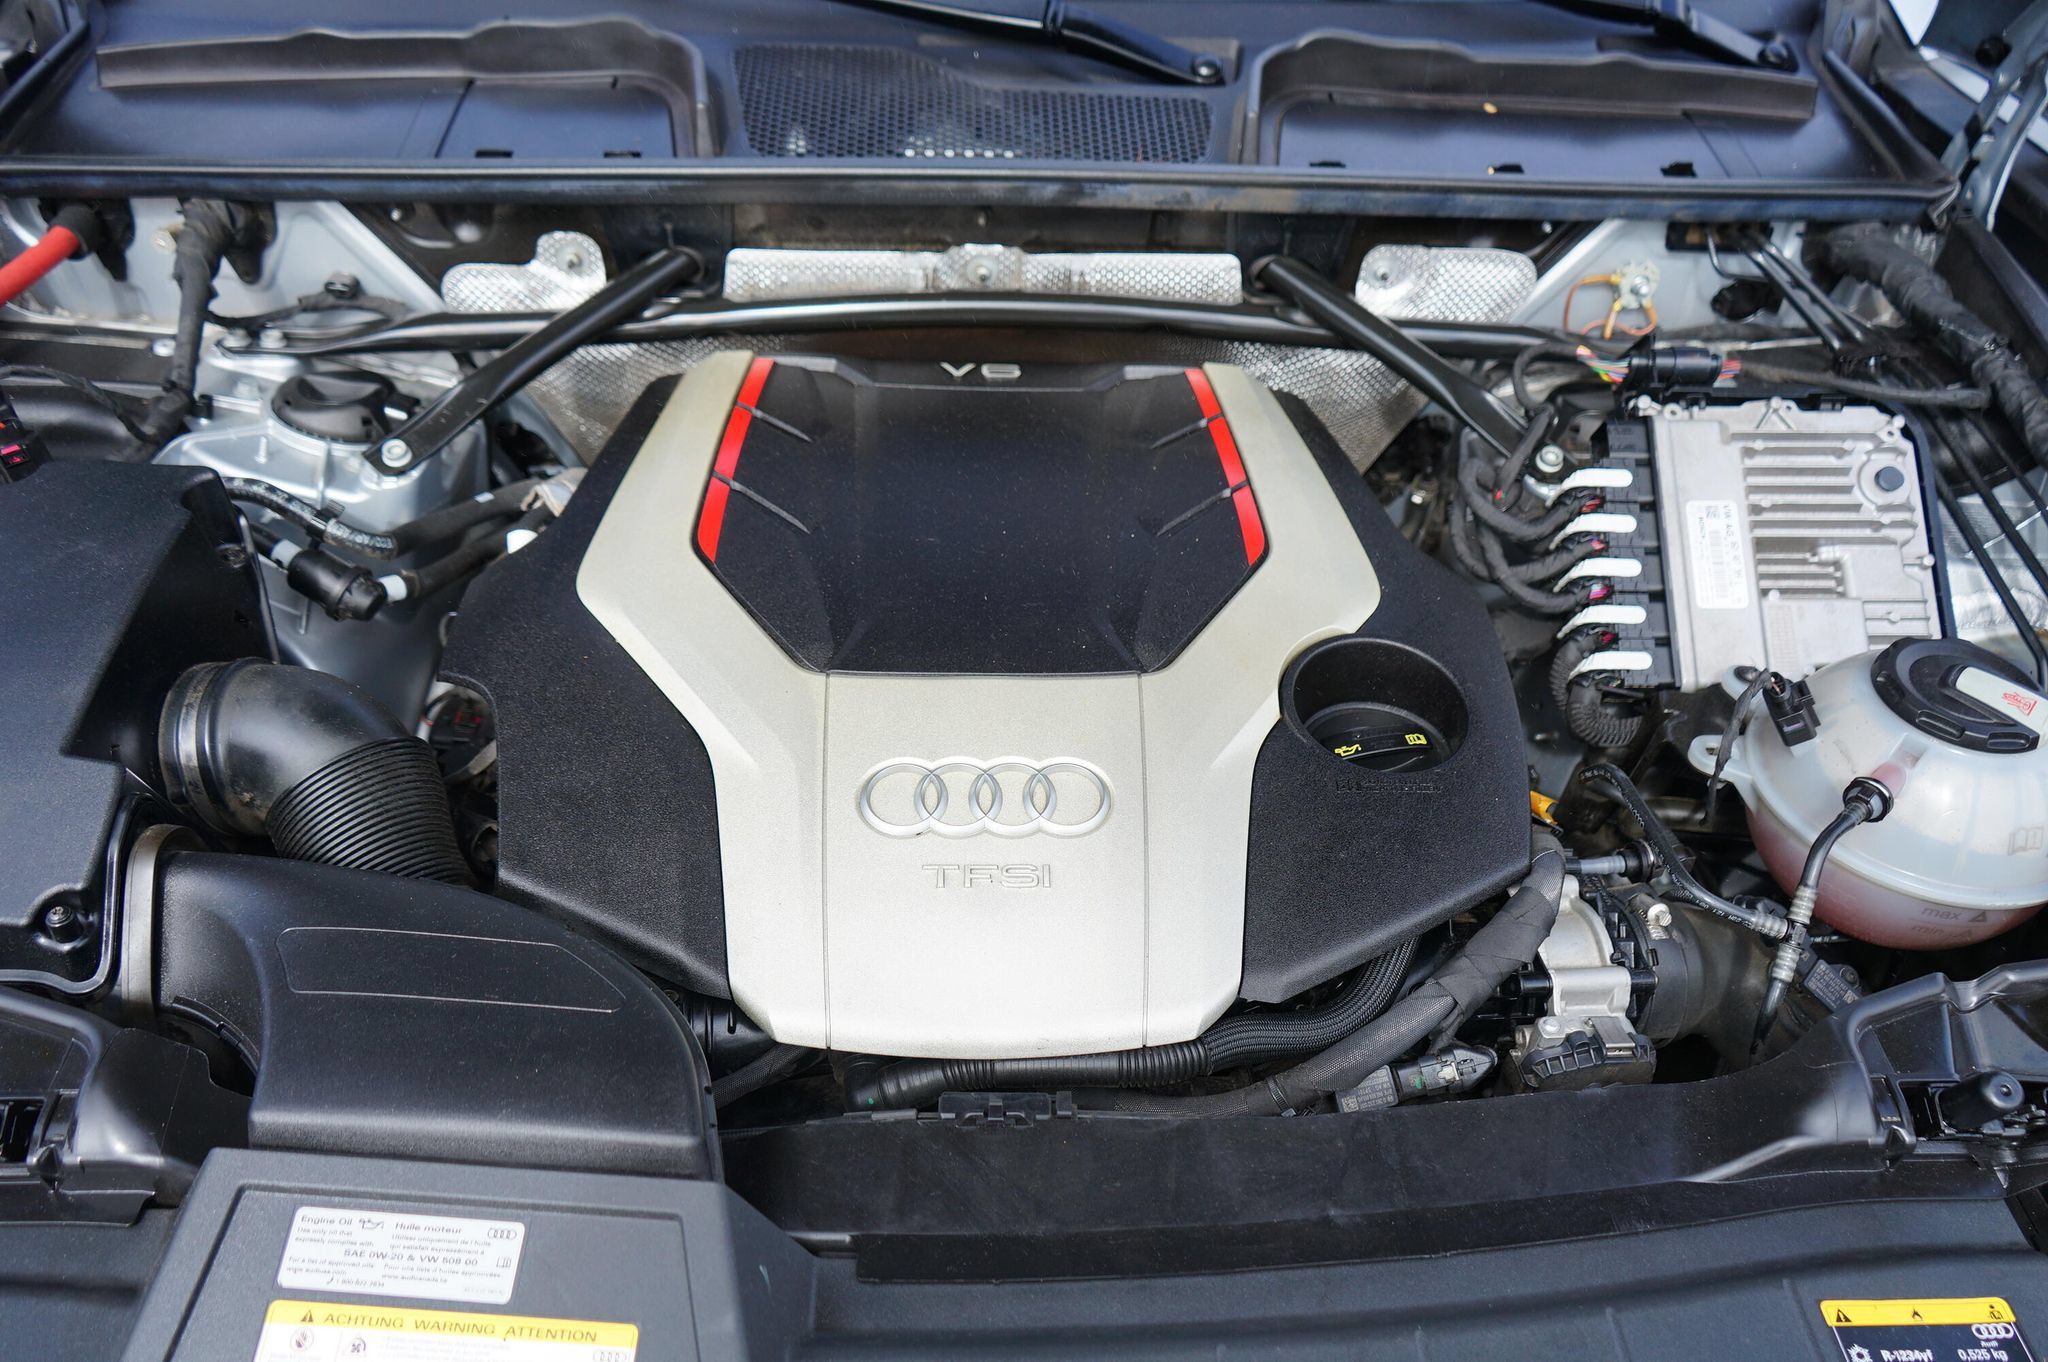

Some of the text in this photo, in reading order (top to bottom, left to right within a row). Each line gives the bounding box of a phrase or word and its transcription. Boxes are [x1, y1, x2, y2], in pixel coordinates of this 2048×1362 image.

[939, 361, 1022, 378] V6
[921, 864, 1052, 889] TFSI
[1921, 907, 1963, 921] max
[1912, 924, 1945, 936] min
[301, 1214, 353, 1226] Engine Oil
[395, 1221, 462, 1235] Huile moteur
[295, 1236, 325, 1246] expressly
[327, 1238, 357, 1246] complies
[343, 1248, 366, 1257] SAE
[368, 1250, 404, 1260] 0W-20
[419, 1255, 440, 1263] VW
[442, 1256, 462, 1265] 508
[464, 1258, 479, 1266] 00
[323, 1313, 598, 1342] ACHTUNG WARNING ATTENTION
[1980, 1340, 1999, 1348] Audi
[1880, 1348, 2009, 1362] R-1234yf 0,525 kg
